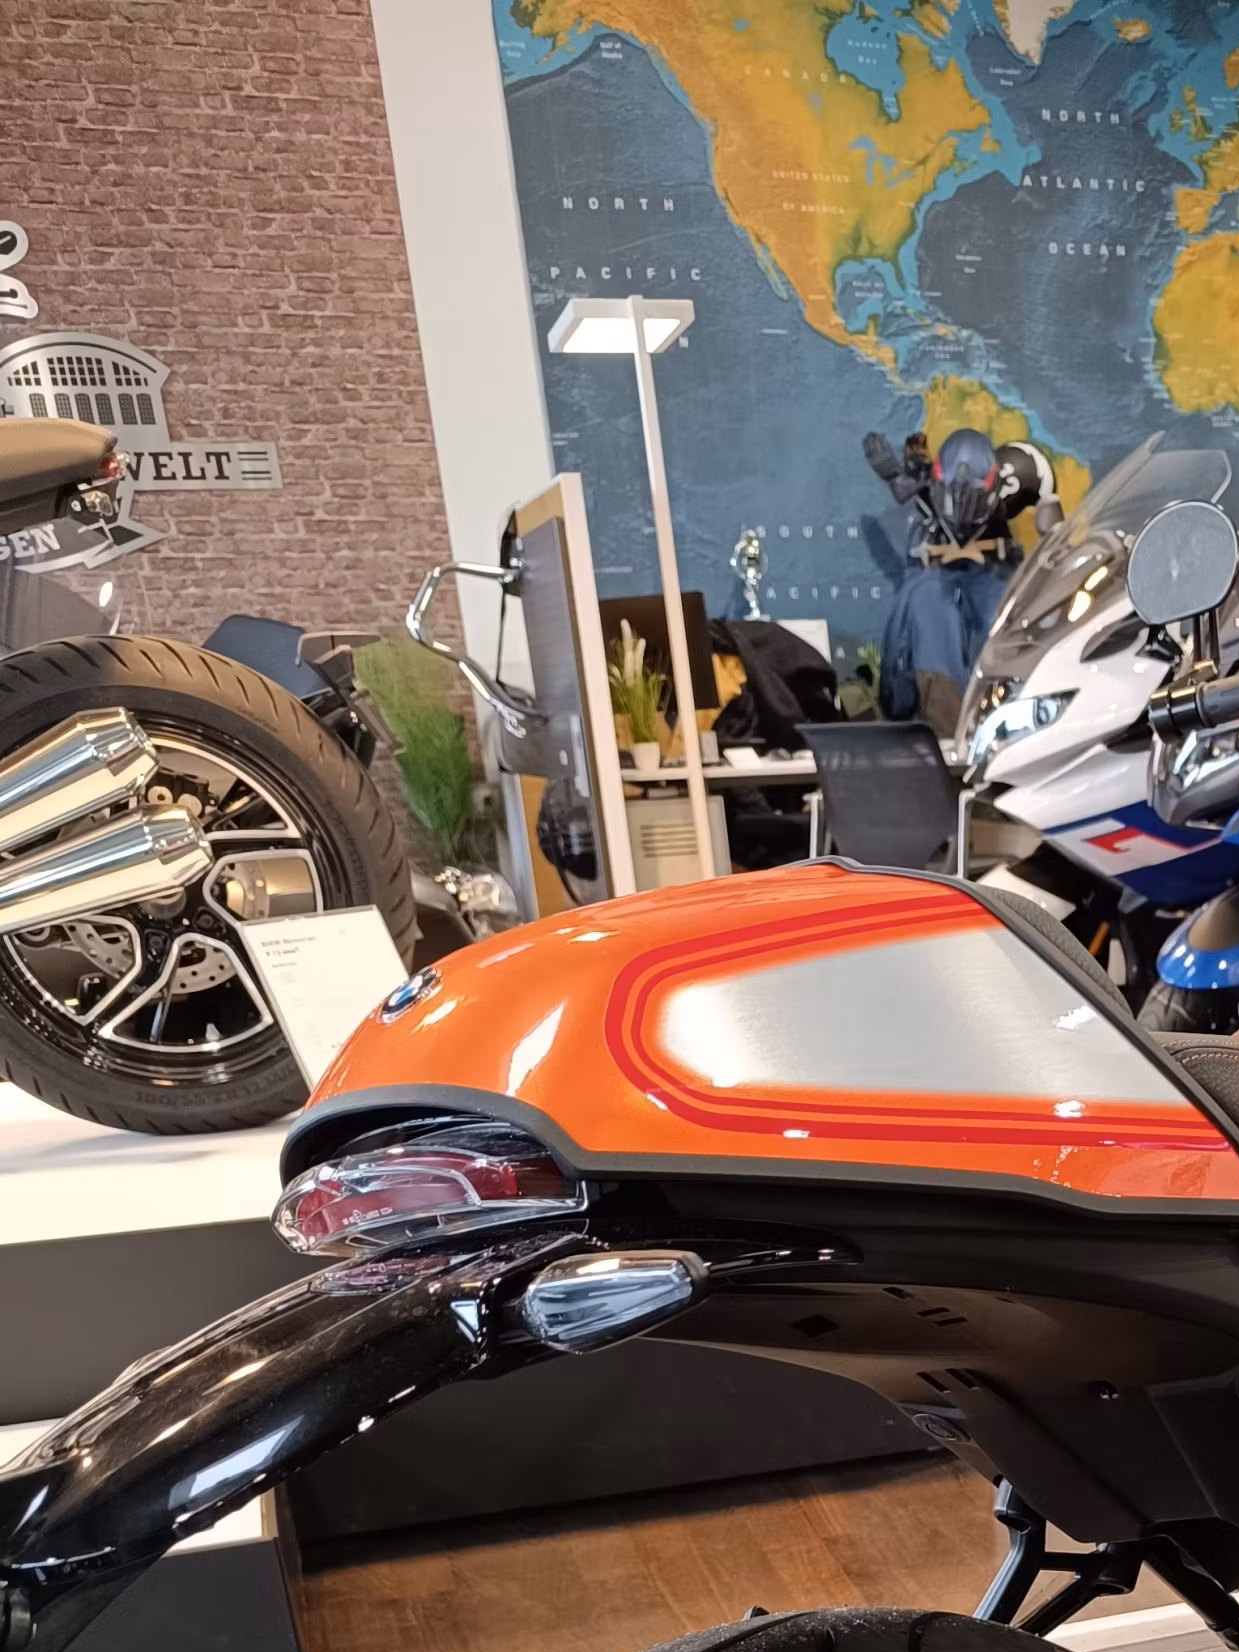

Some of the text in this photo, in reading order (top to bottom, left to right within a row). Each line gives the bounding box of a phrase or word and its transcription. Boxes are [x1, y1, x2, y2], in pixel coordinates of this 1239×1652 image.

[1041, 109, 1120, 124] NORTH
[1022, 175, 1145, 192] ATLANTIC
[564, 197, 674, 211] NORTH
[1048, 242, 1126, 257] OCEAN
[550, 266, 702, 281] PACIFIC
[765, 585, 881, 600] ACIFIC
